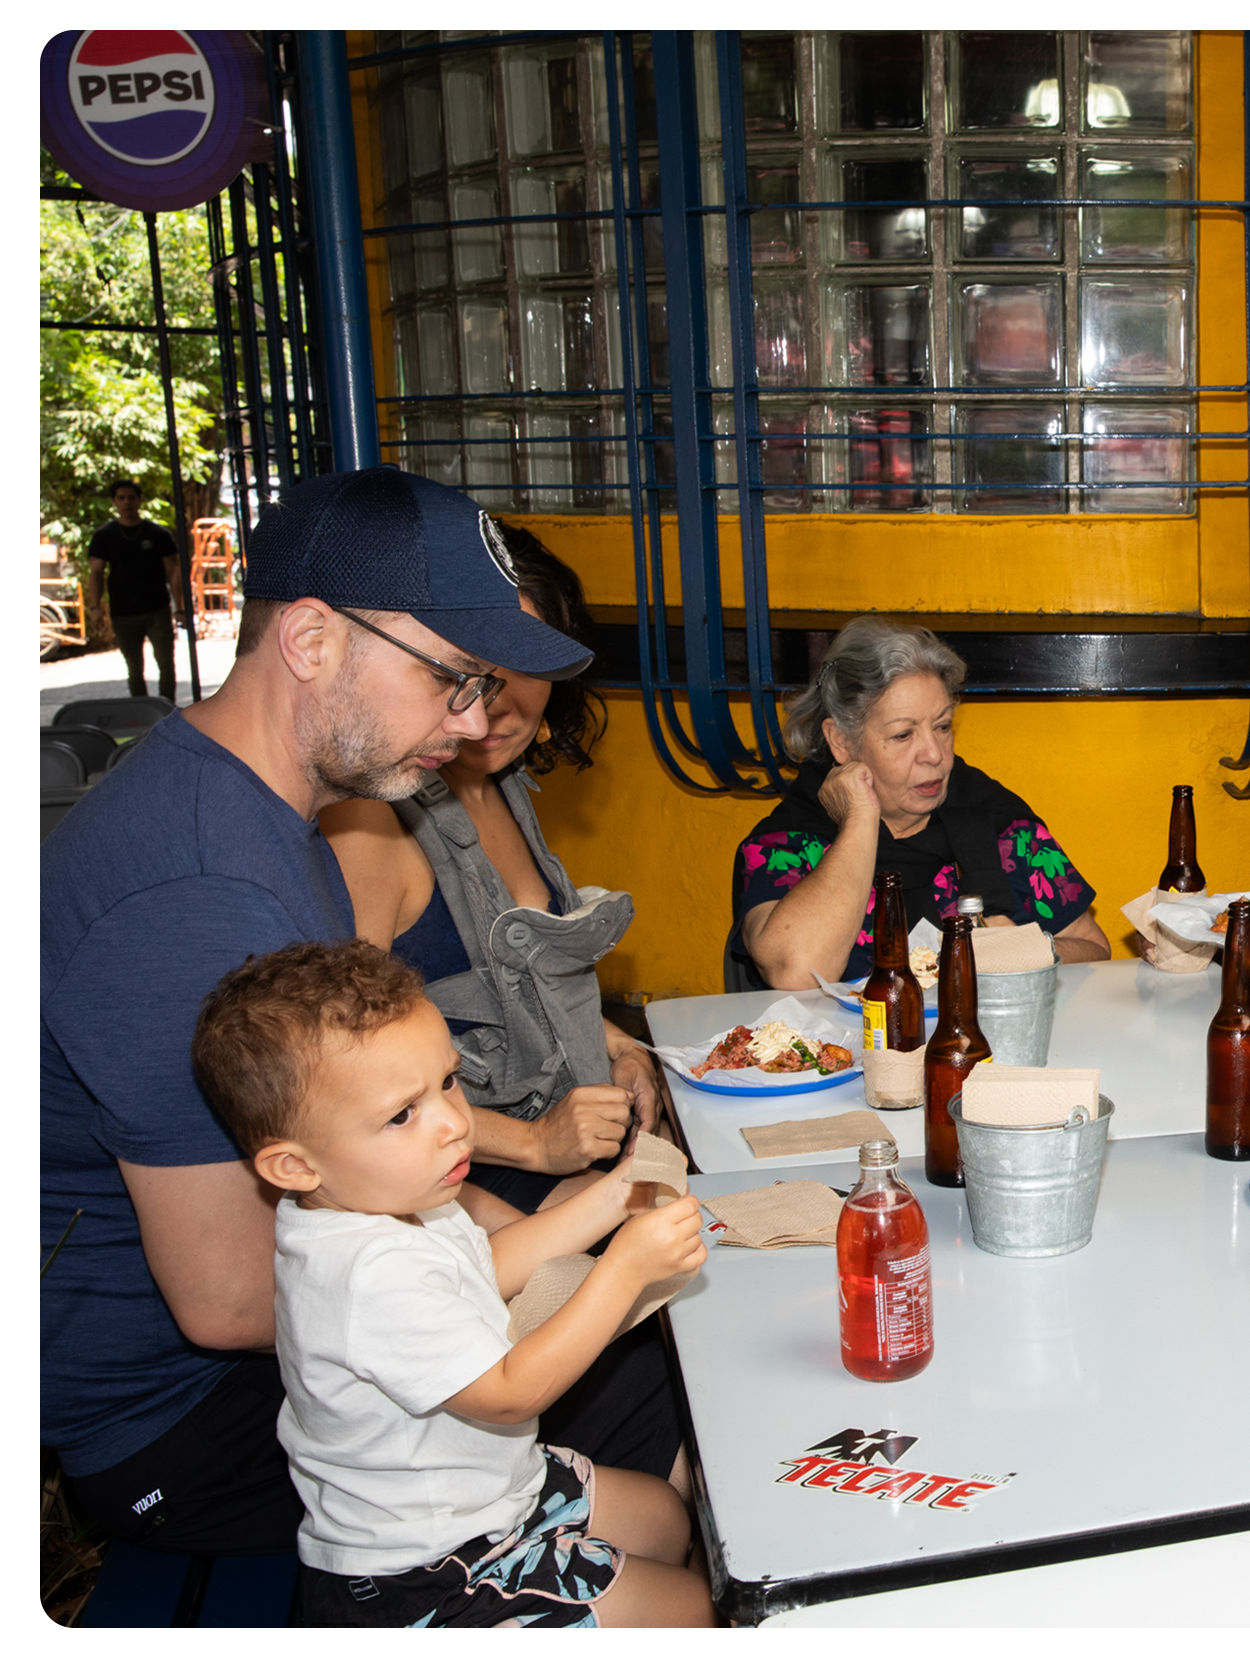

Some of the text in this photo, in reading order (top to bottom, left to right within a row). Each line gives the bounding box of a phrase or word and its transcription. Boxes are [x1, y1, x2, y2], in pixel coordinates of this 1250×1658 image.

[78, 69, 205, 106] PEPSI
[131, 1488, 164, 1515] vuori
[778, 1456, 997, 1510] TECATE
